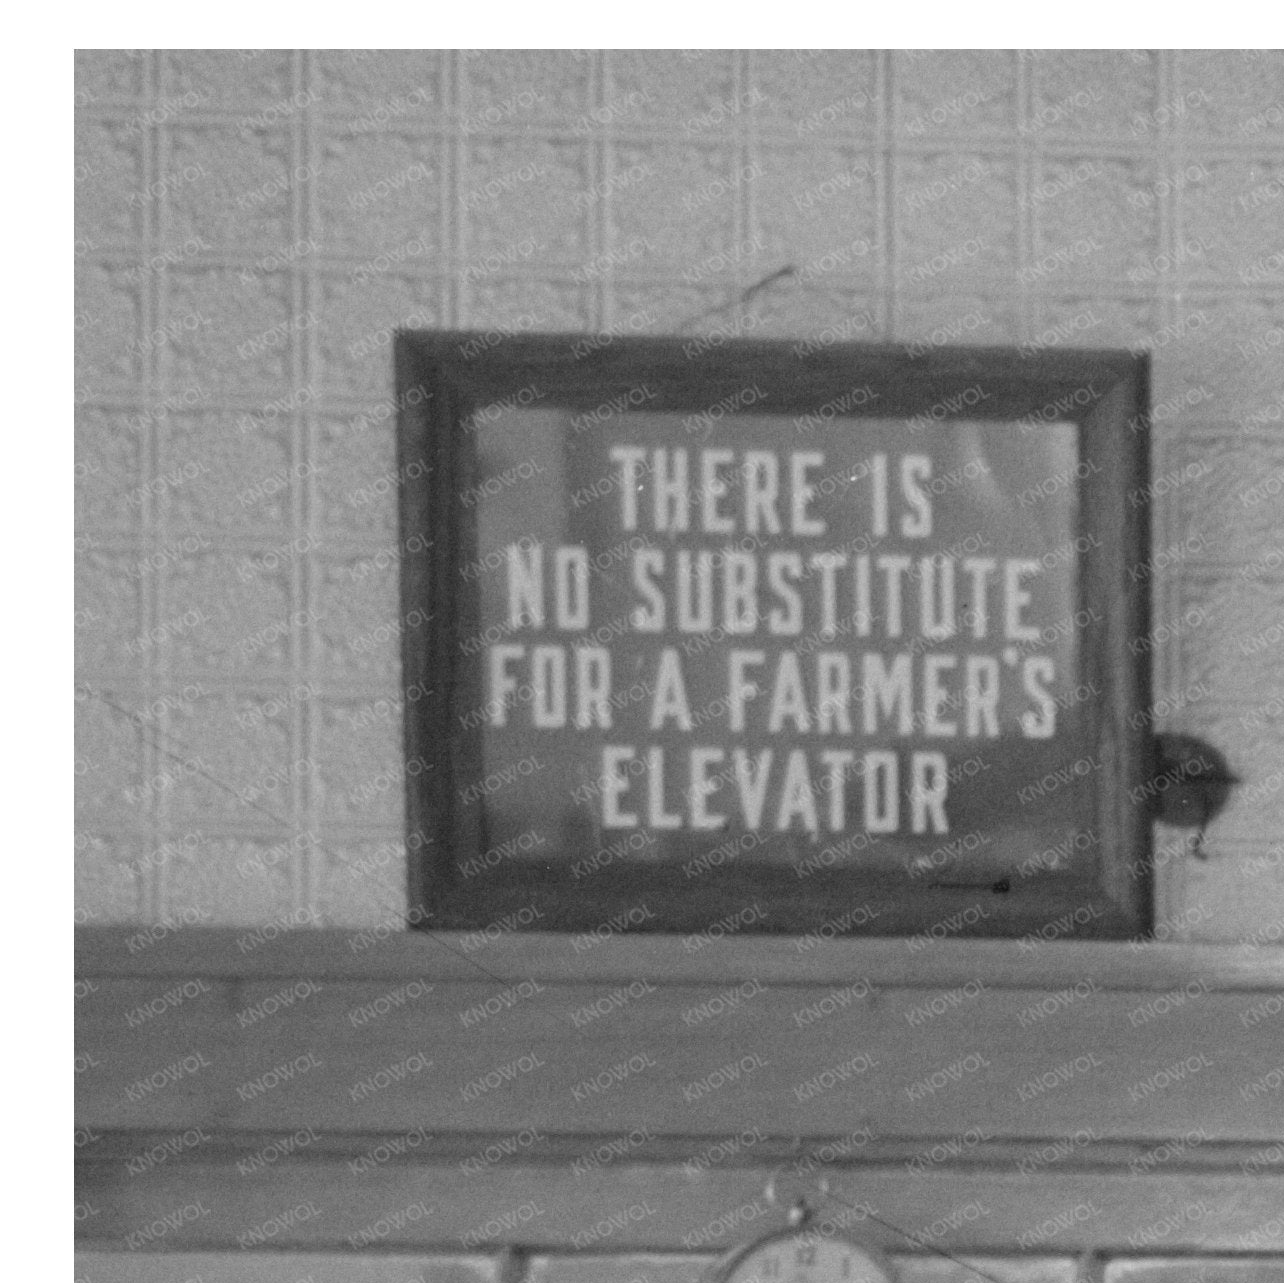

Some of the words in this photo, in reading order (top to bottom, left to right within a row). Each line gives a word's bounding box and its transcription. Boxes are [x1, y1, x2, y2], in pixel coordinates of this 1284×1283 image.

[610, 446, 826, 536] THERE
[872, 454, 933, 537] IS
[506, 544, 590, 631] NO
[633, 549, 1042, 641] SUBSTITUTE
[489, 645, 611, 729] FOR
[650, 649, 690, 731] A
[729, 648, 1057, 739] FARMER'S
[601, 746, 949, 835] ELEVATOR
